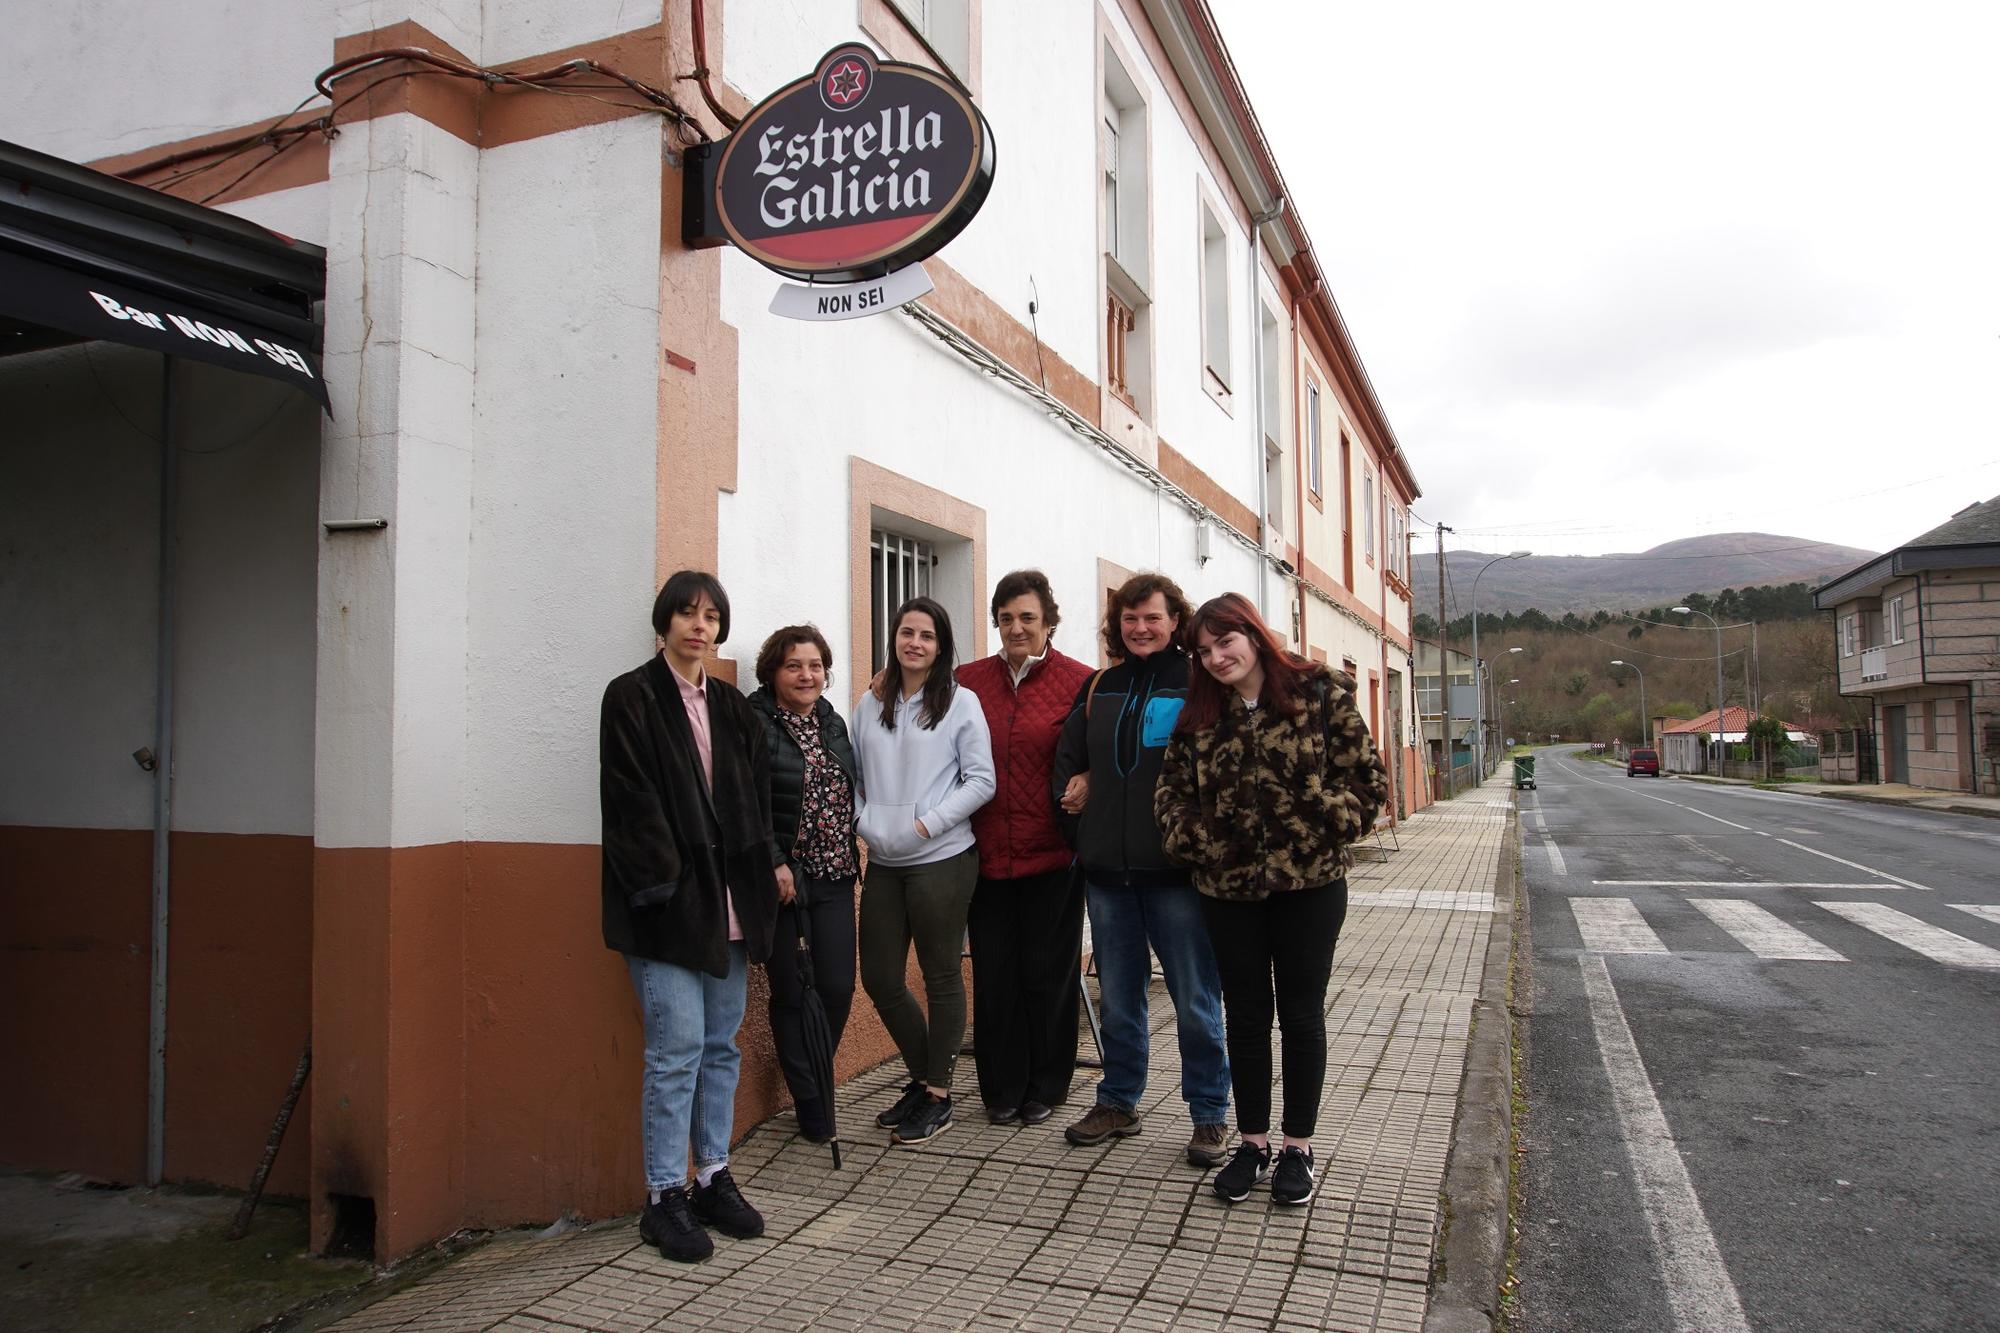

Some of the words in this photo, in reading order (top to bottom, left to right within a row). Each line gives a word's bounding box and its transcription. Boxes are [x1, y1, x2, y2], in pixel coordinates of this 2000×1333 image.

[754, 105, 944, 176] Estrella
[761, 159, 932, 228] Galicia
[89, 291, 166, 330] Bar
[166, 314, 257, 354] NON
[253, 339, 313, 378] SEI
[817, 296, 852, 314] NON
[859, 286, 884, 309] SEI
